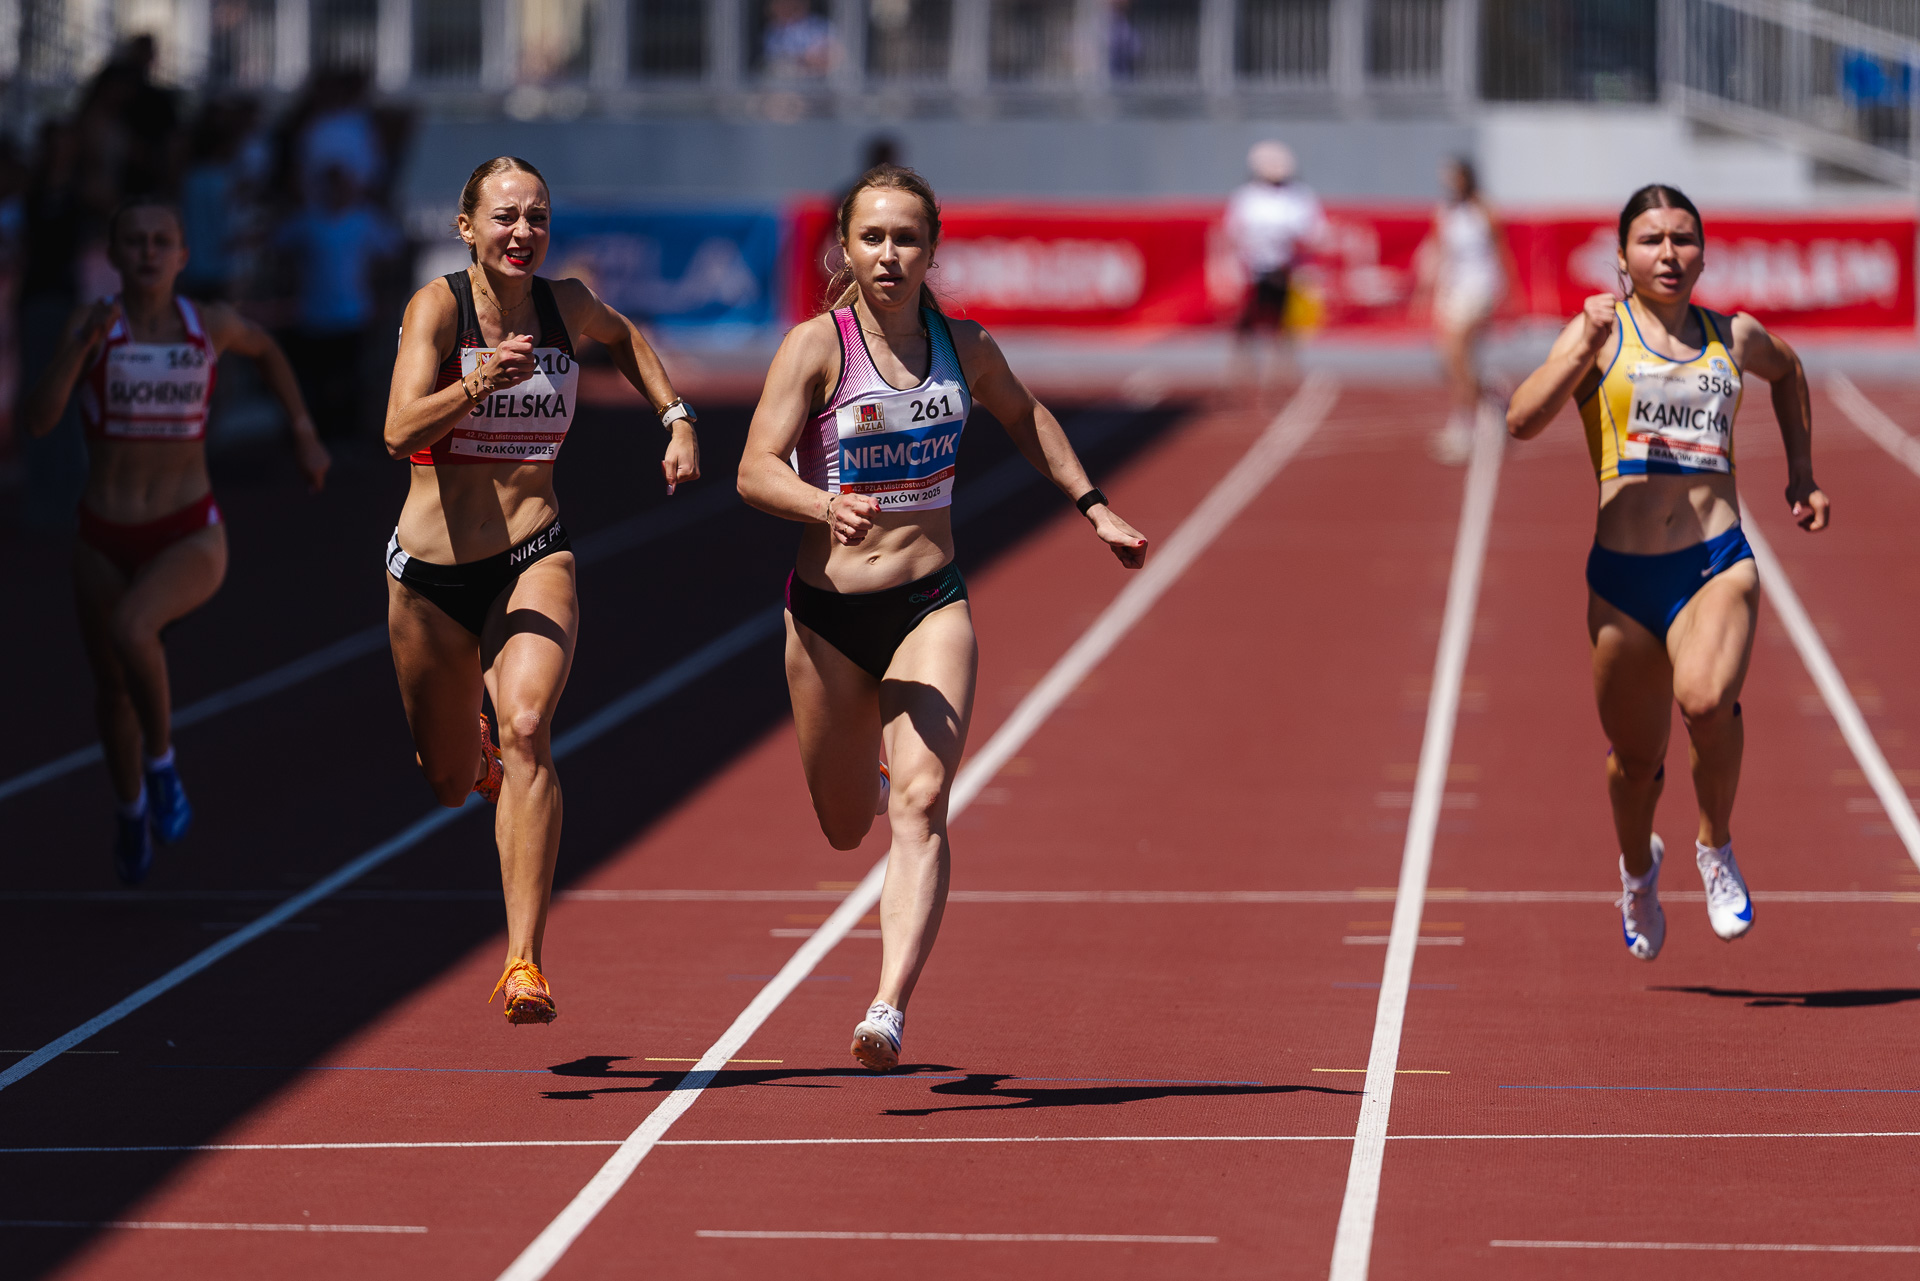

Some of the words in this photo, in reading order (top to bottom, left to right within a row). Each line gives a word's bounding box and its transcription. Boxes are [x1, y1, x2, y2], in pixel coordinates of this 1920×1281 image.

[1698, 374, 1732, 397] 358
[910, 395, 953, 422] 261
[1635, 400, 1729, 437] KANICKA
[495, 432, 533, 440] Mistrzostwa
[535, 433, 554, 441] Polski
[857, 421, 883, 432] MZLA
[476, 443, 527, 454] KRAKÓW
[528, 446, 555, 454] 2025
[843, 432, 958, 471] NIEMCZYK
[876, 491, 920, 505] RAKÓW
[922, 486, 941, 500] 2025
[884, 481, 926, 490] Mistrzostwa
[510, 534, 547, 566] NIKE
[549, 521, 561, 542] PR
